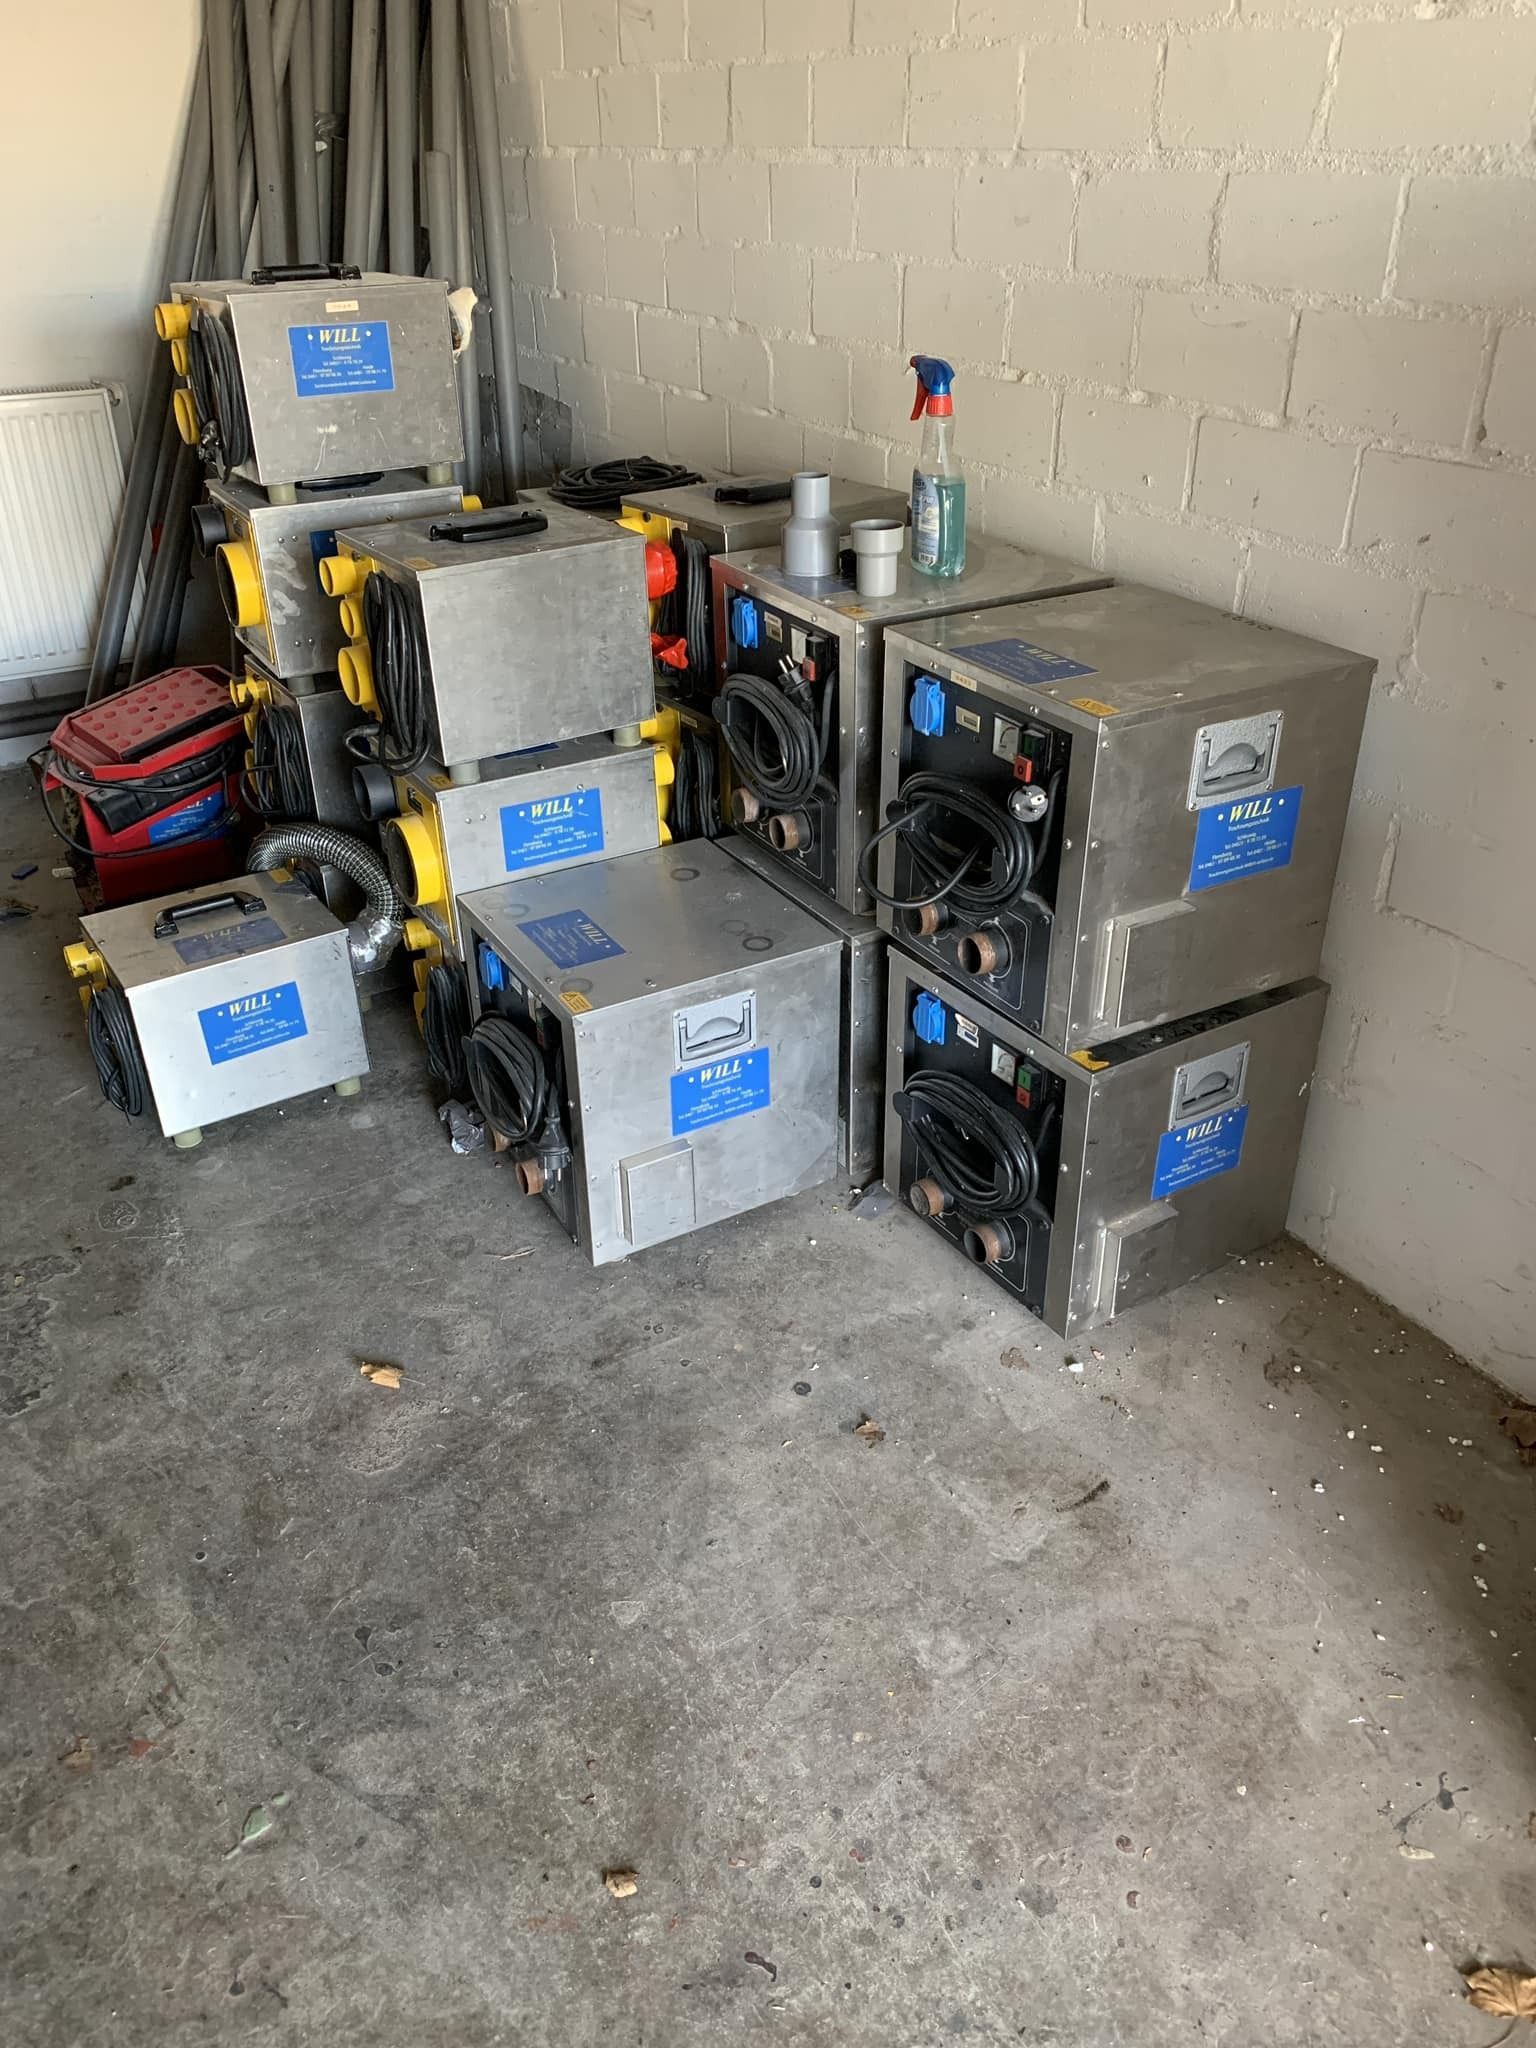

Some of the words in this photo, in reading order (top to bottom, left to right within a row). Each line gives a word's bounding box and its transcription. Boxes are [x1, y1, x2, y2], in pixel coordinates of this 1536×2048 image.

[320, 328, 361, 344] WILL
[531, 796, 573, 818] WILL
[1229, 798, 1272, 824] WILL
[576, 923, 608, 945] WILL
[229, 993, 271, 1017] WILL
[701, 1059, 742, 1083] WILL
[1186, 1115, 1223, 1142] WILL
